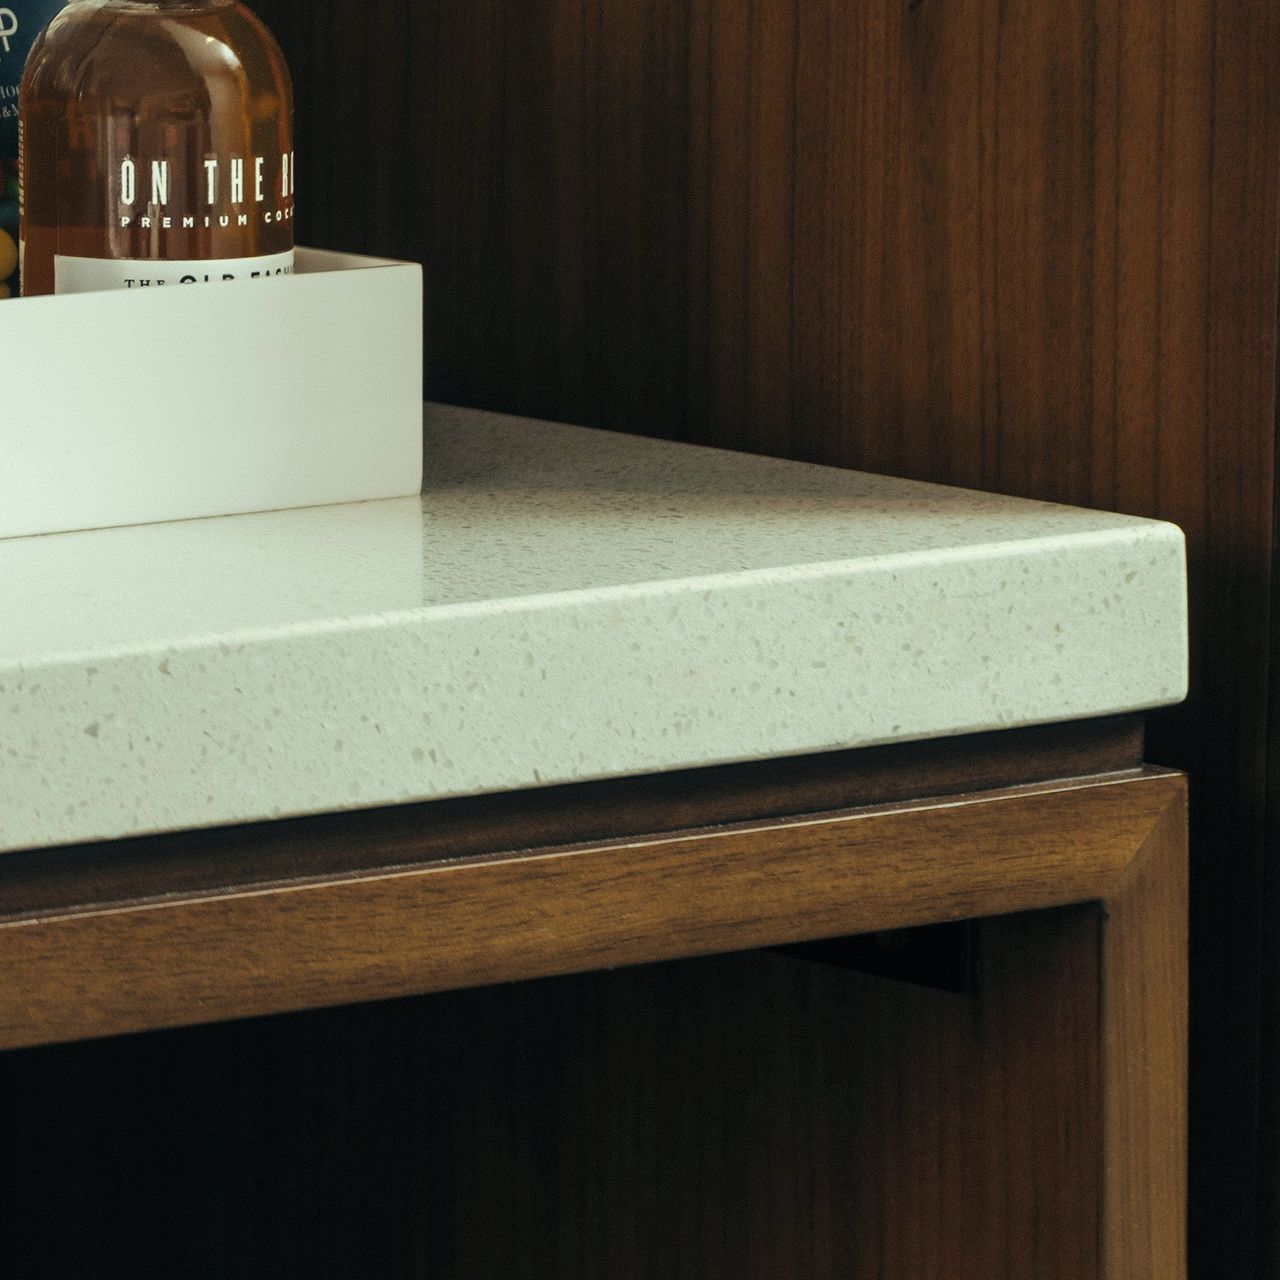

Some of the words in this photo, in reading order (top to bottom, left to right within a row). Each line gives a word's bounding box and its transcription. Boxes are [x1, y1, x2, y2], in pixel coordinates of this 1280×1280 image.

[119, 158, 168, 206] ON
[203, 156, 265, 205] THE
[120, 214, 248, 229] PREMIUM
